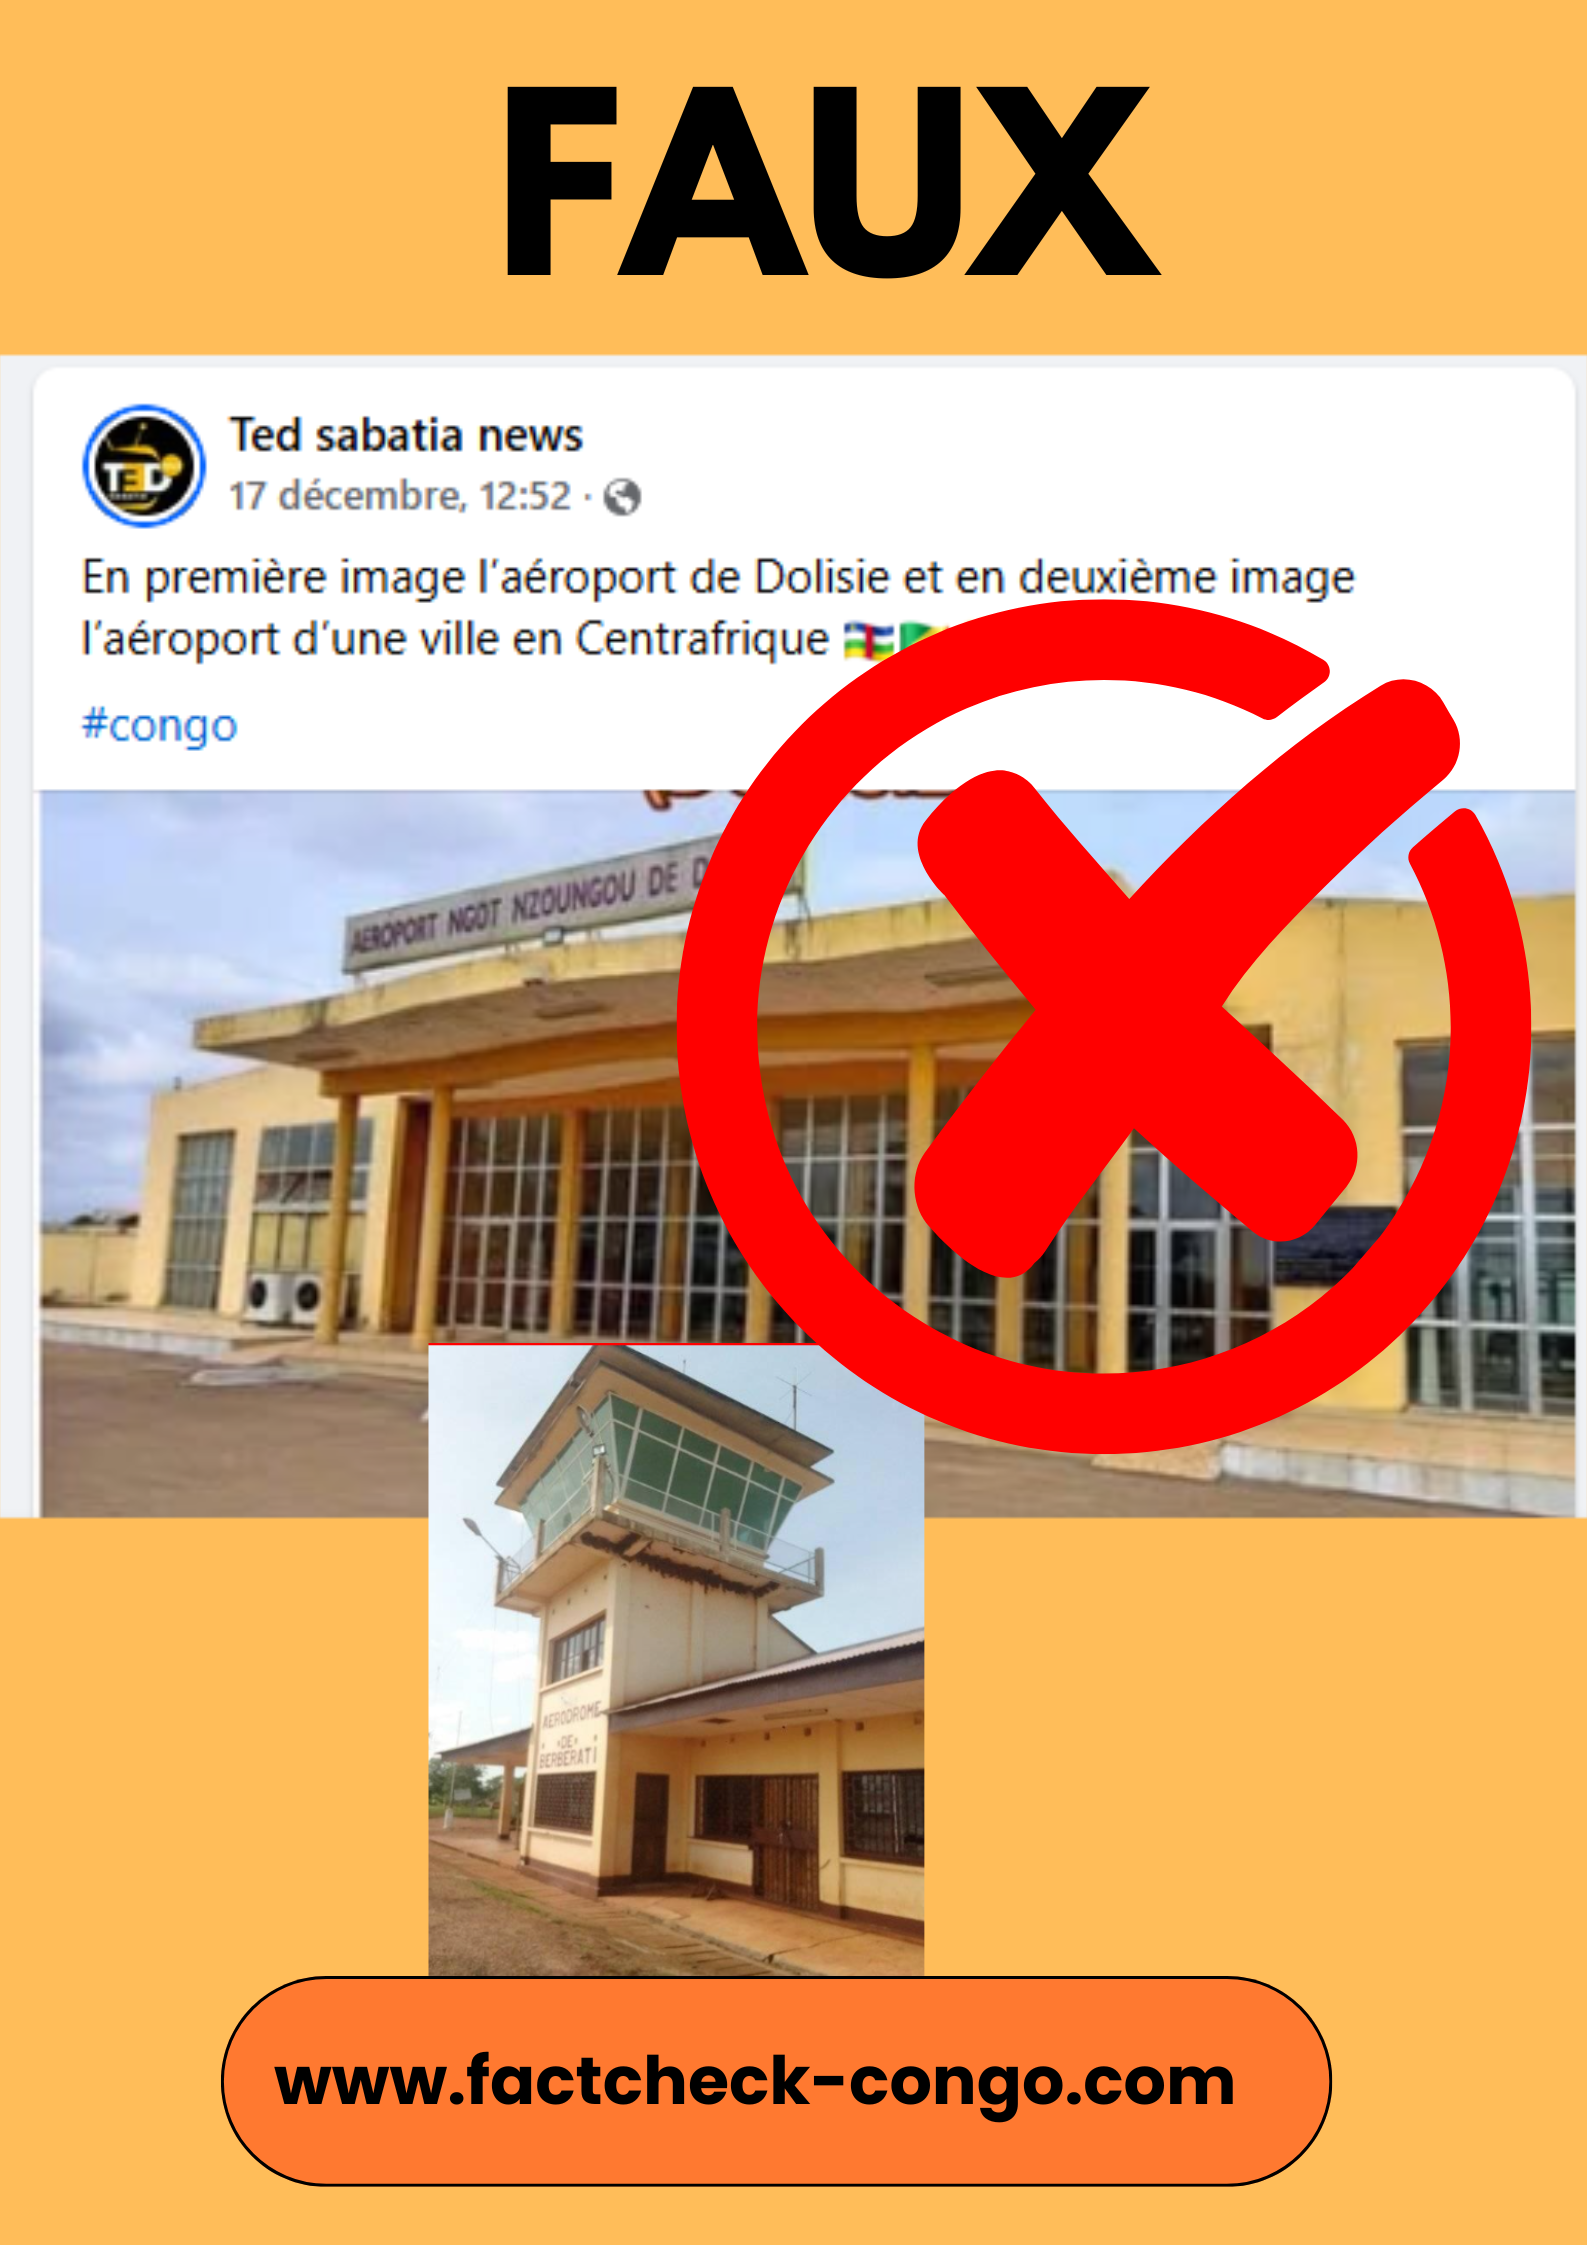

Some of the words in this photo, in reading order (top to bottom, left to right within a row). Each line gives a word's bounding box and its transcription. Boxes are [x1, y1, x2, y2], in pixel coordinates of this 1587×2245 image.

[228, 415, 302, 452] Ted
[316, 415, 462, 452] sabatia
[479, 425, 583, 452] news
[231, 481, 267, 510] 17
[279, 479, 466, 513] décembre,
[481, 481, 571, 510] 12:52
[83, 558, 129, 594] En
[146, 558, 327, 603] première
[341, 558, 466, 603] image
[690, 558, 740, 594] de
[756, 558, 891, 594] Dolisie
[903, 561, 943, 594] et
[956, 567, 1005, 594] en
[1019, 557, 1217, 594] deuxième
[1231, 558, 1355, 603] image
[419, 619, 499, 656] ville
[513, 629, 561, 656] en
[576, 619, 829, 665] Centrafrique
[82, 706, 237, 751] #congo
[350, 911, 438, 953] AEROPORT
[448, 897, 502, 935] NGOT
[511, 868, 635, 923] NZOUNGOU
[648, 861, 678, 897] DE
[542, 1700, 602, 1729] AERODROME
[539, 1746, 597, 1769] BERBERATI
